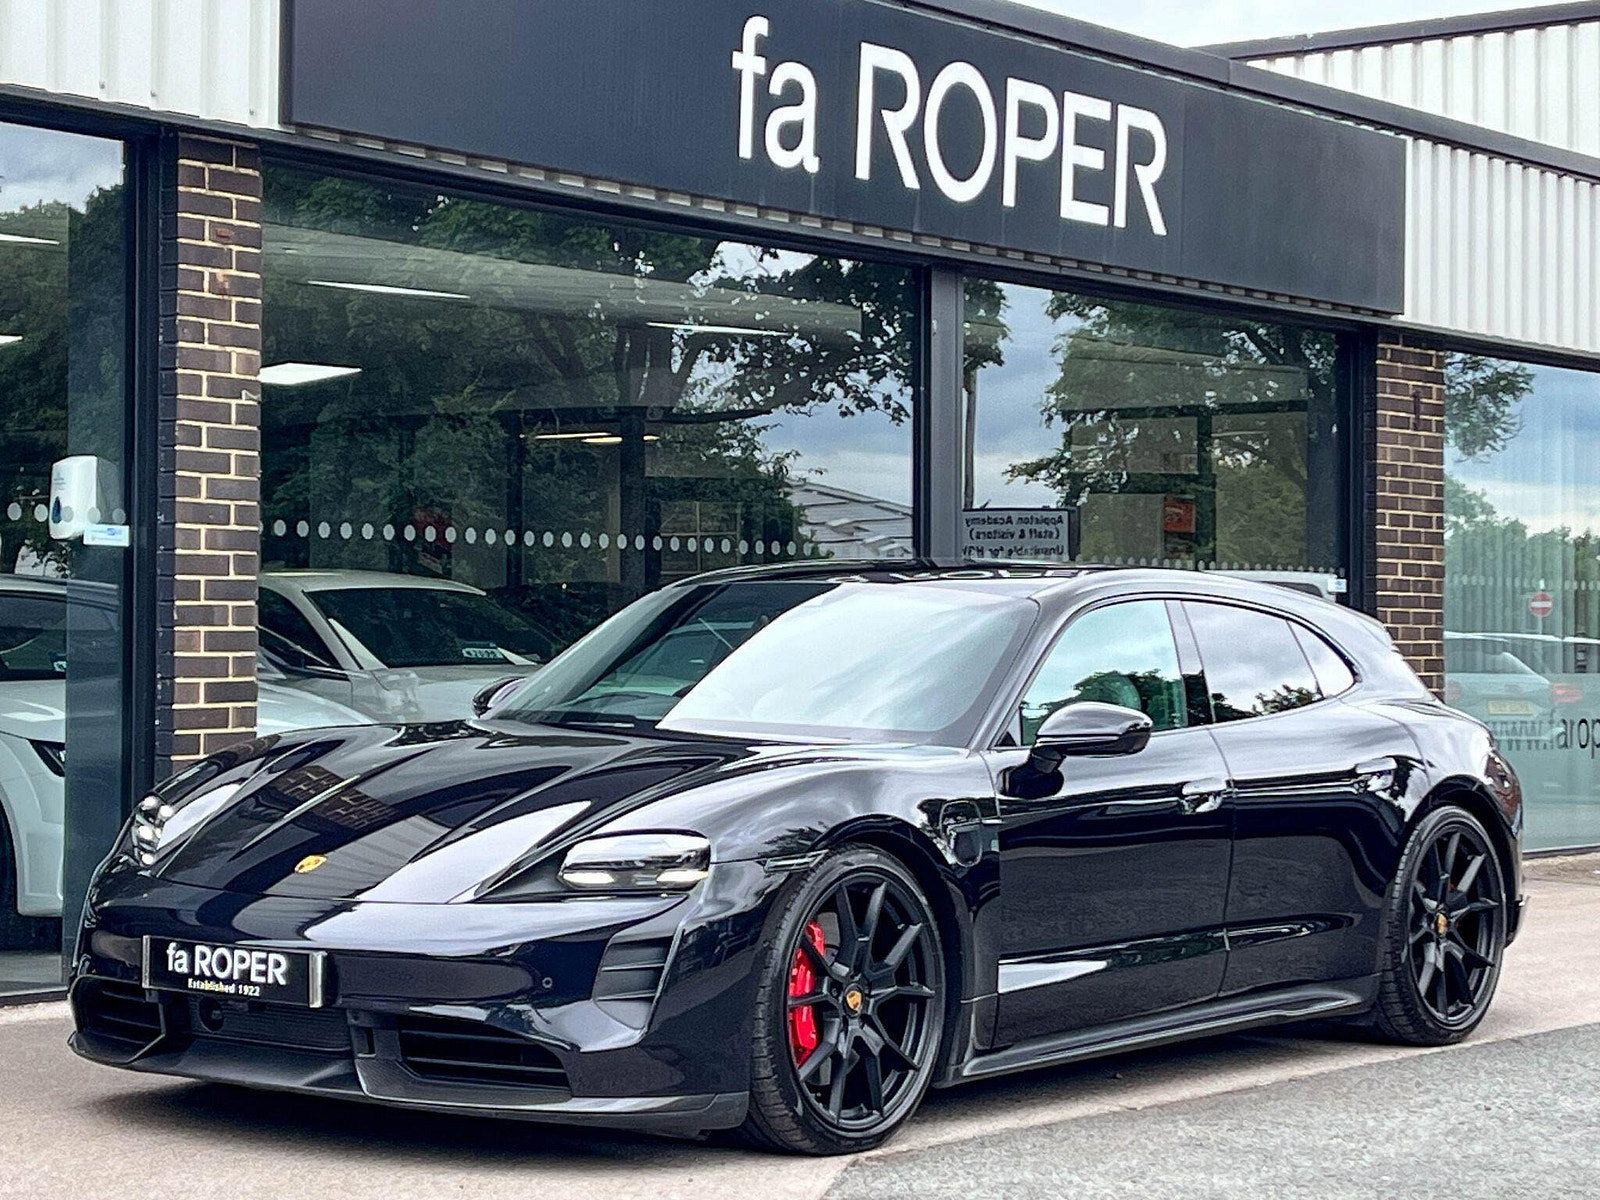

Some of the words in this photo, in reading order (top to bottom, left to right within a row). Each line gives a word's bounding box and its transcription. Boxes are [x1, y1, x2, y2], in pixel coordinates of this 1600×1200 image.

[732, 15, 820, 174] fa
[855, 41, 1168, 237] ROPER
[166, 942, 189, 974] fa
[194, 944, 287, 986] ROPER
[188, 978, 236, 994] Established
